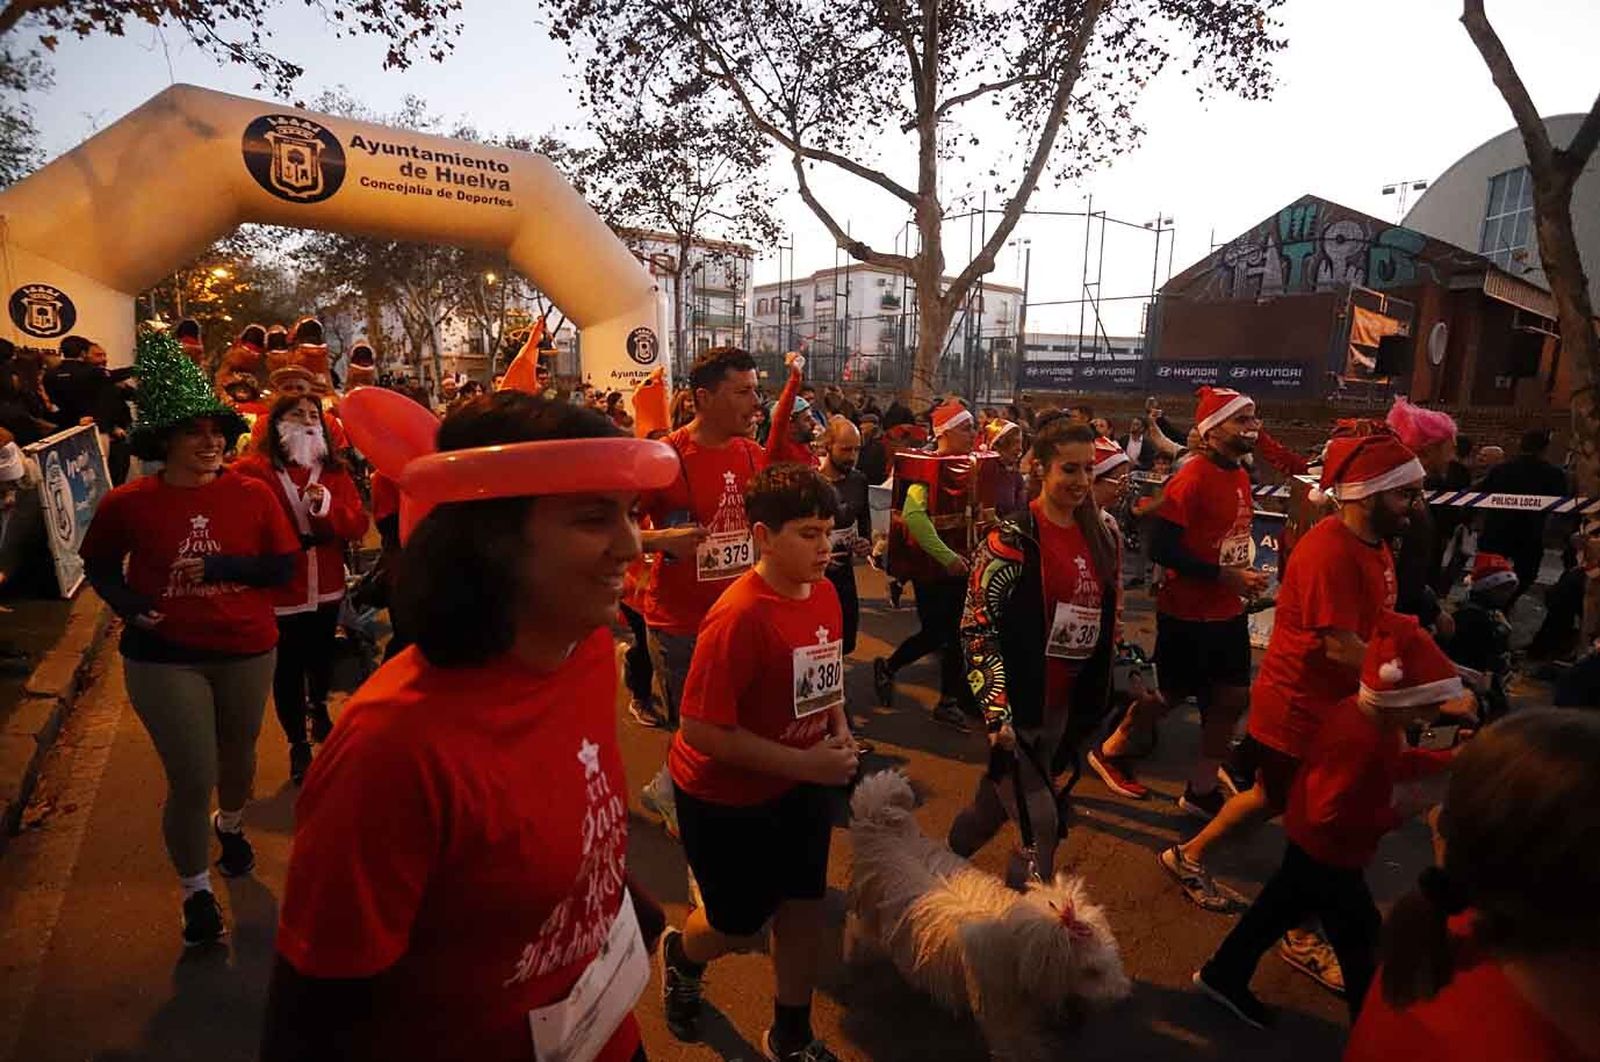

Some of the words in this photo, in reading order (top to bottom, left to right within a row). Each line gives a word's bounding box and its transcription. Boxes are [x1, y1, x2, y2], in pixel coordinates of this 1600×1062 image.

[350, 134, 509, 174] Ayuntamiento
[399, 161, 428, 179] de
[436, 166, 511, 192] Huelva
[436, 187, 453, 199] de
[456, 190, 514, 207] Deportes
[1098, 367, 1136, 376] HYUNDAI
[1173, 367, 1218, 377] HYUNDAI
[1250, 368, 1302, 378] HYUNDAI
[1519, 498, 1542, 506] LOCAL
[723, 543, 749, 565] 379
[817, 660, 841, 691] 380
